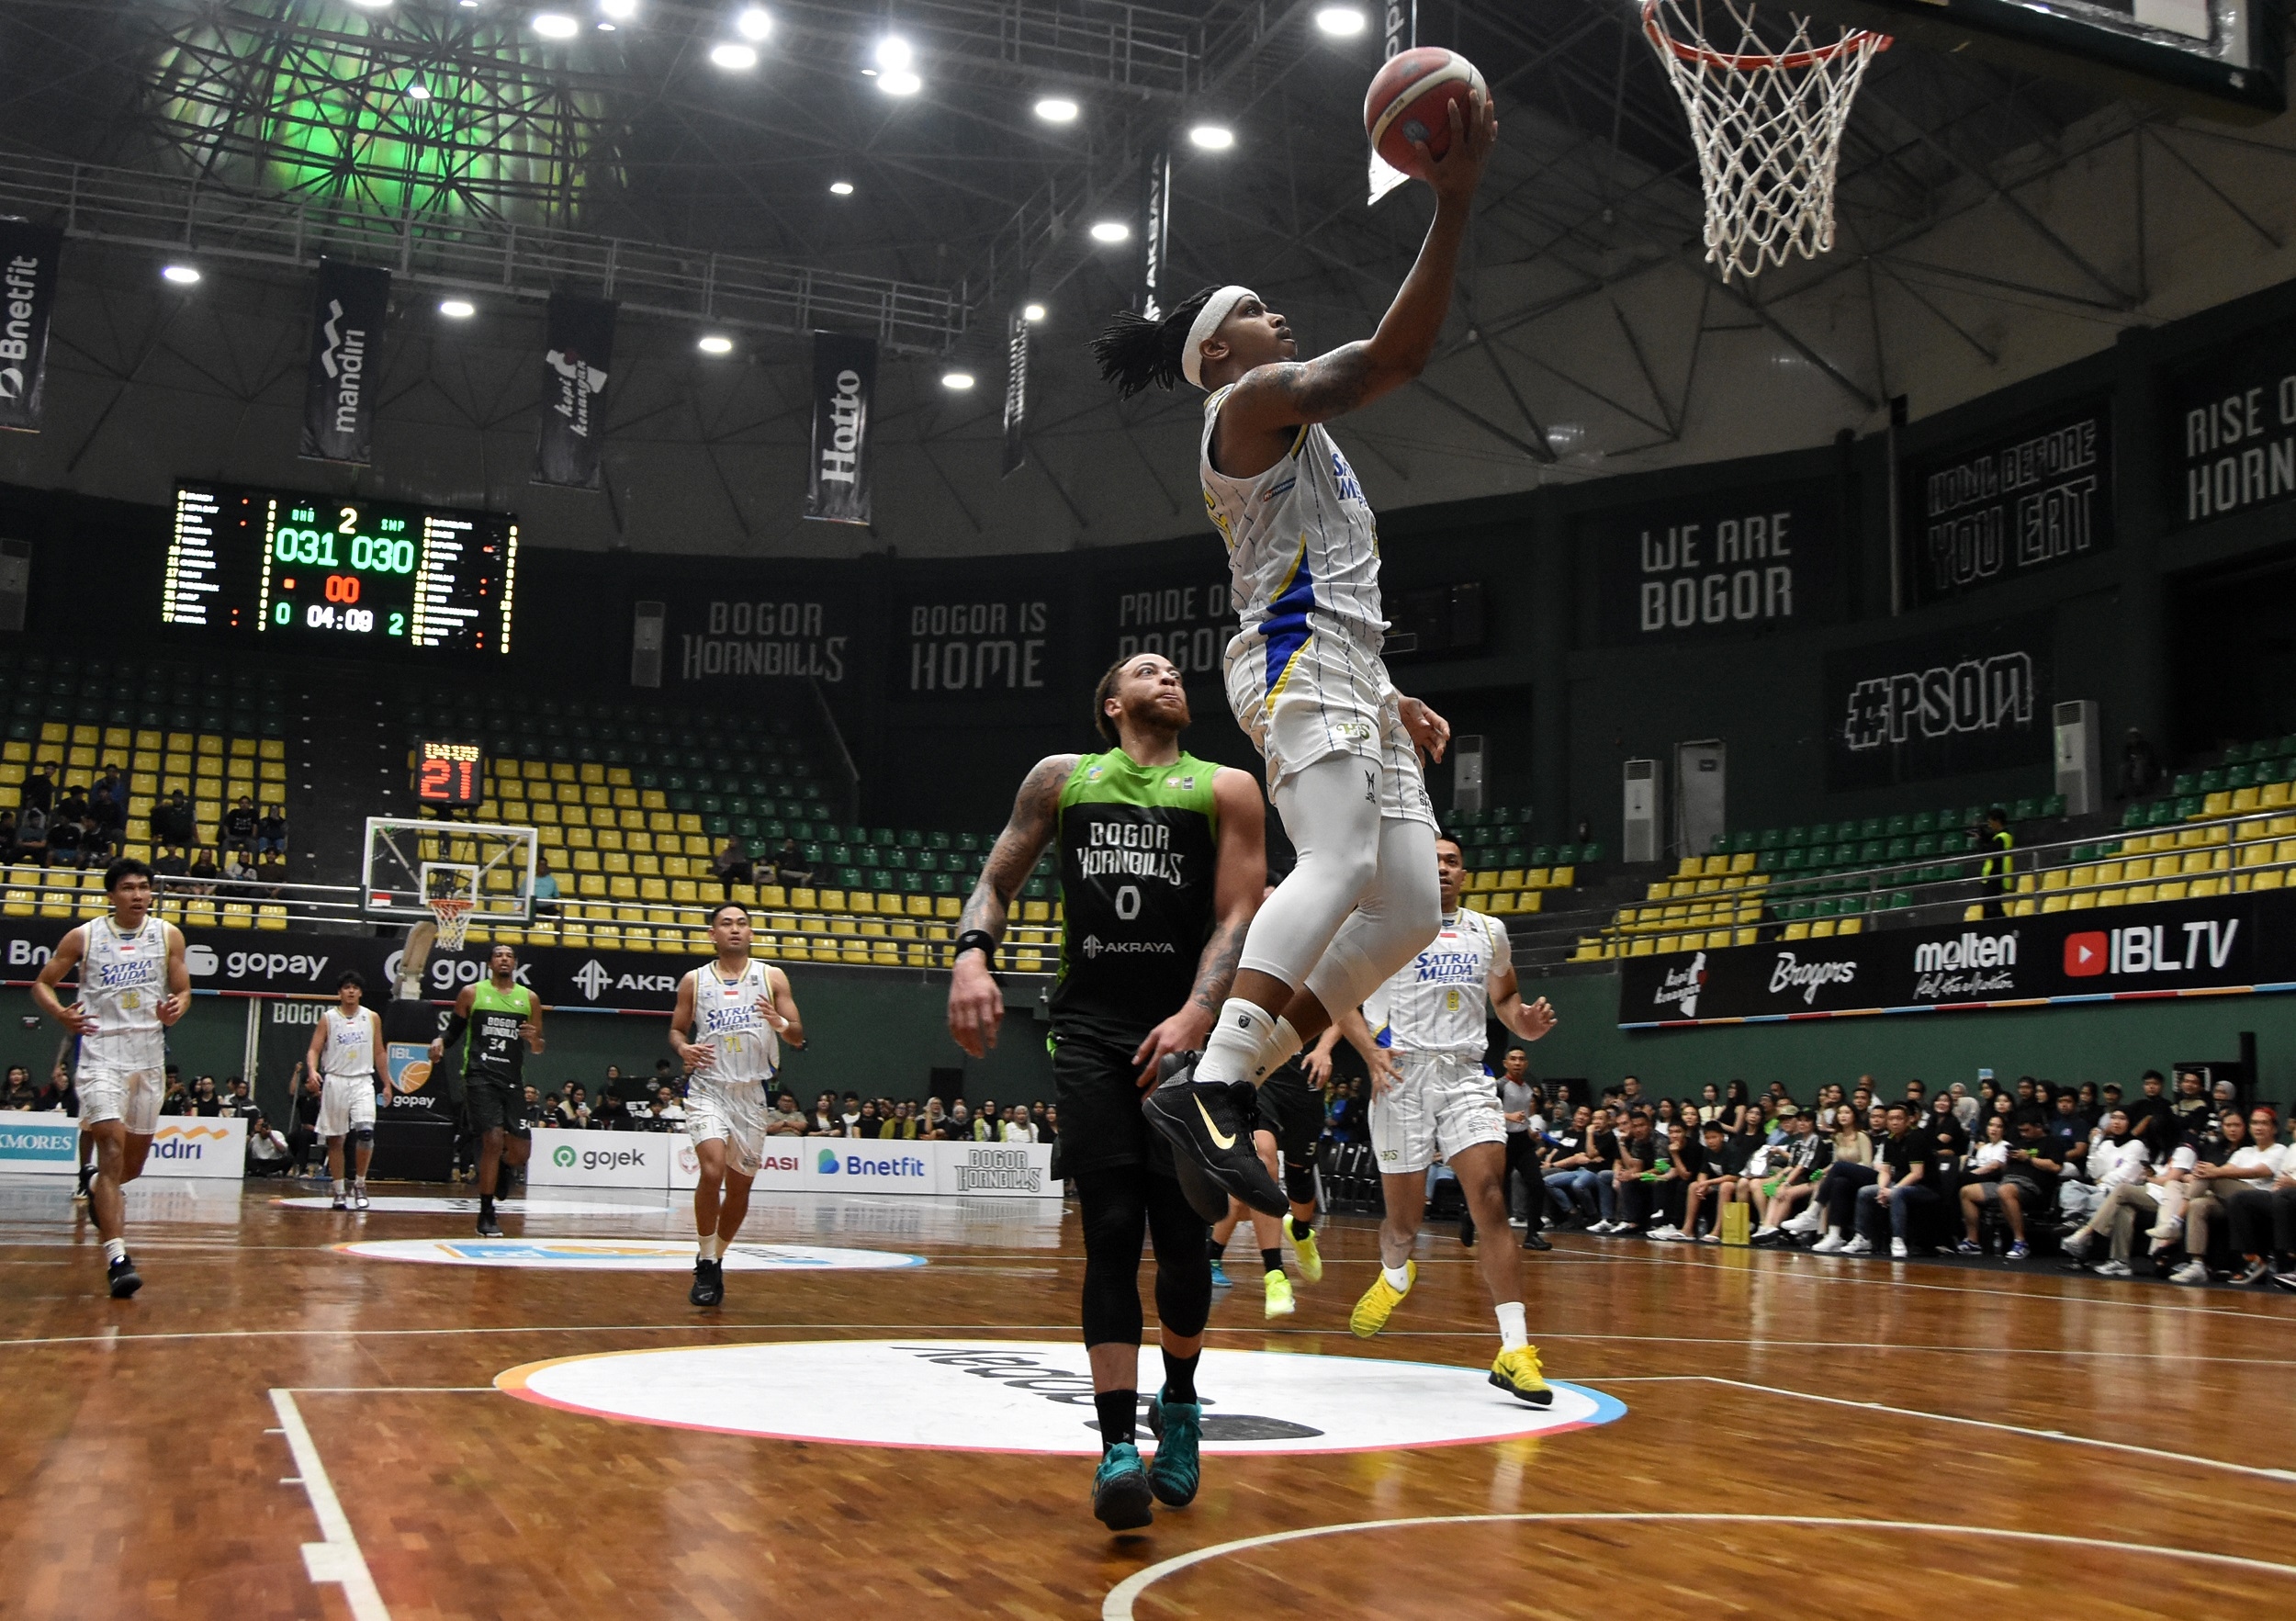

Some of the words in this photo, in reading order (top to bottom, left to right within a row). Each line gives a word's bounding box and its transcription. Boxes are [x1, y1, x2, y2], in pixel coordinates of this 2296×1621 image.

[0, 255, 39, 360] Bnetfit
[335, 329, 366, 433] mandiri
[821, 368, 861, 483] Hotto
[2187, 387, 2265, 457] RISE
[1999, 418, 2097, 493] BEFORE
[338, 506, 359, 535] 2
[1930, 505, 2003, 589] YOU
[2019, 474, 2097, 567] EAT
[276, 527, 339, 568] 031
[350, 535, 415, 575] 030
[1641, 523, 1700, 574] WE
[1716, 512, 1792, 563] ARE
[325, 574, 361, 603] 00
[1640, 566, 1793, 633] BOGOR
[275, 601, 291, 625] 0
[388, 612, 405, 636] 2
[708, 601, 823, 637] BOGOR
[911, 602, 1007, 636] BOGOR
[1019, 602, 1047, 634] IS
[1120, 587, 1198, 626] PRIDE
[682, 634, 848, 683] HORNBILLS
[910, 639, 1046, 691] HOME
[1845, 651, 2033, 750] #PSOM
[421, 760, 472, 800] 21
[1090, 822, 1170, 850] BOGOR
[1076, 847, 1185, 886] HORNBILLS
[1115, 885, 1142, 920] 0
[1105, 942, 1176, 953] AKRAYA
[1414, 951, 1479, 969] SATRIA
[1914, 931, 2017, 973] molten
[99, 960, 153, 977] SATRIA
[100, 969, 148, 987] MUDA
[227, 951, 329, 981] gopay
[1415, 964, 1473, 983] MUDA
[616, 974, 679, 992] AKR
[273, 1002, 337, 1024] BOGO
[705, 1004, 758, 1023] SATRIA
[1446, 990, 1459, 1011] 8
[488, 1016, 517, 1028] BOGOR
[708, 1014, 751, 1033] MUDA
[391, 1047, 414, 1059] IBL
[489, 1038, 506, 1052] 34
[392, 1095, 435, 1108] gopay
[151, 1137, 201, 1159] ndiri
[582, 1148, 645, 1170] gojek
[969, 1149, 1028, 1169] BOGOR
[847, 1155, 925, 1176] Bnetfit
[954, 1165, 1042, 1192] HORNBILLS
